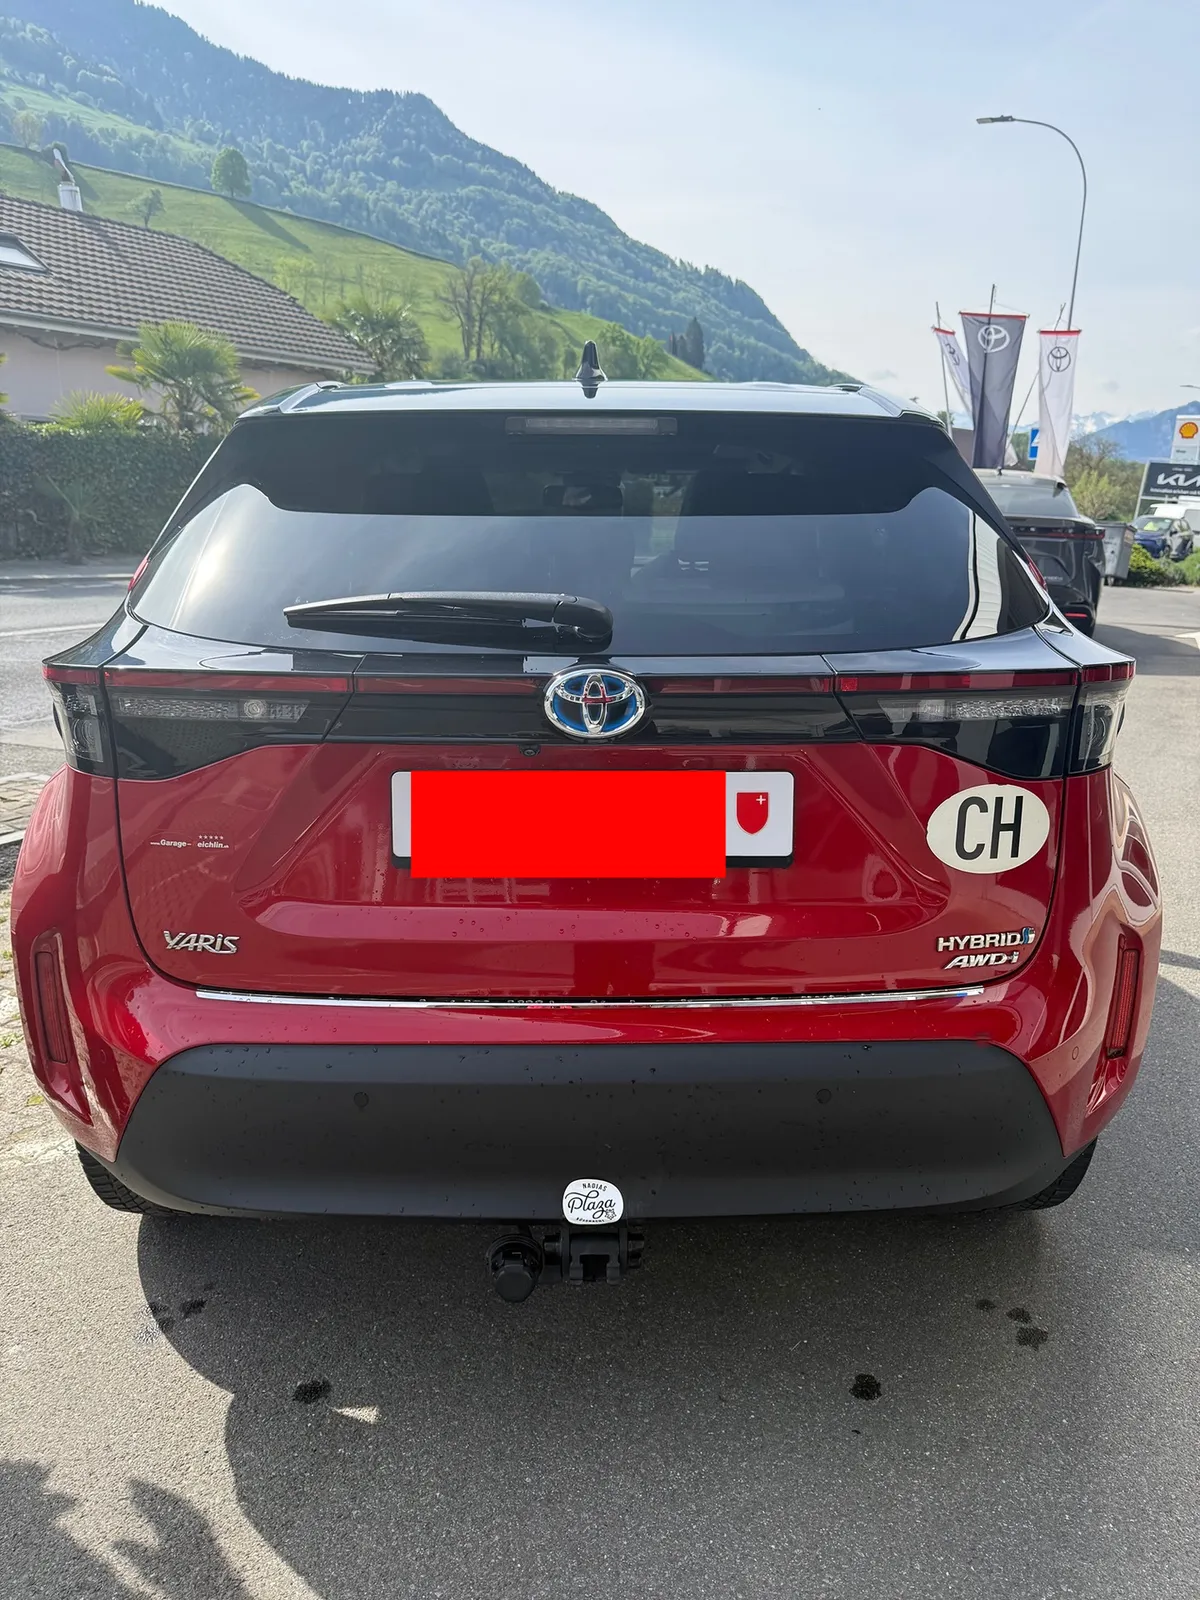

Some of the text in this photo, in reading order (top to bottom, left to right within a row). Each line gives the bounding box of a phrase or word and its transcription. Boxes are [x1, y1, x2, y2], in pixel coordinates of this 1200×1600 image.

[955, 796, 1023, 860] CH
[944, 951, 1019, 969] AWD-i
[582, 1183, 608, 1192] NADIAS
[565, 1189, 616, 1219] Plaza
